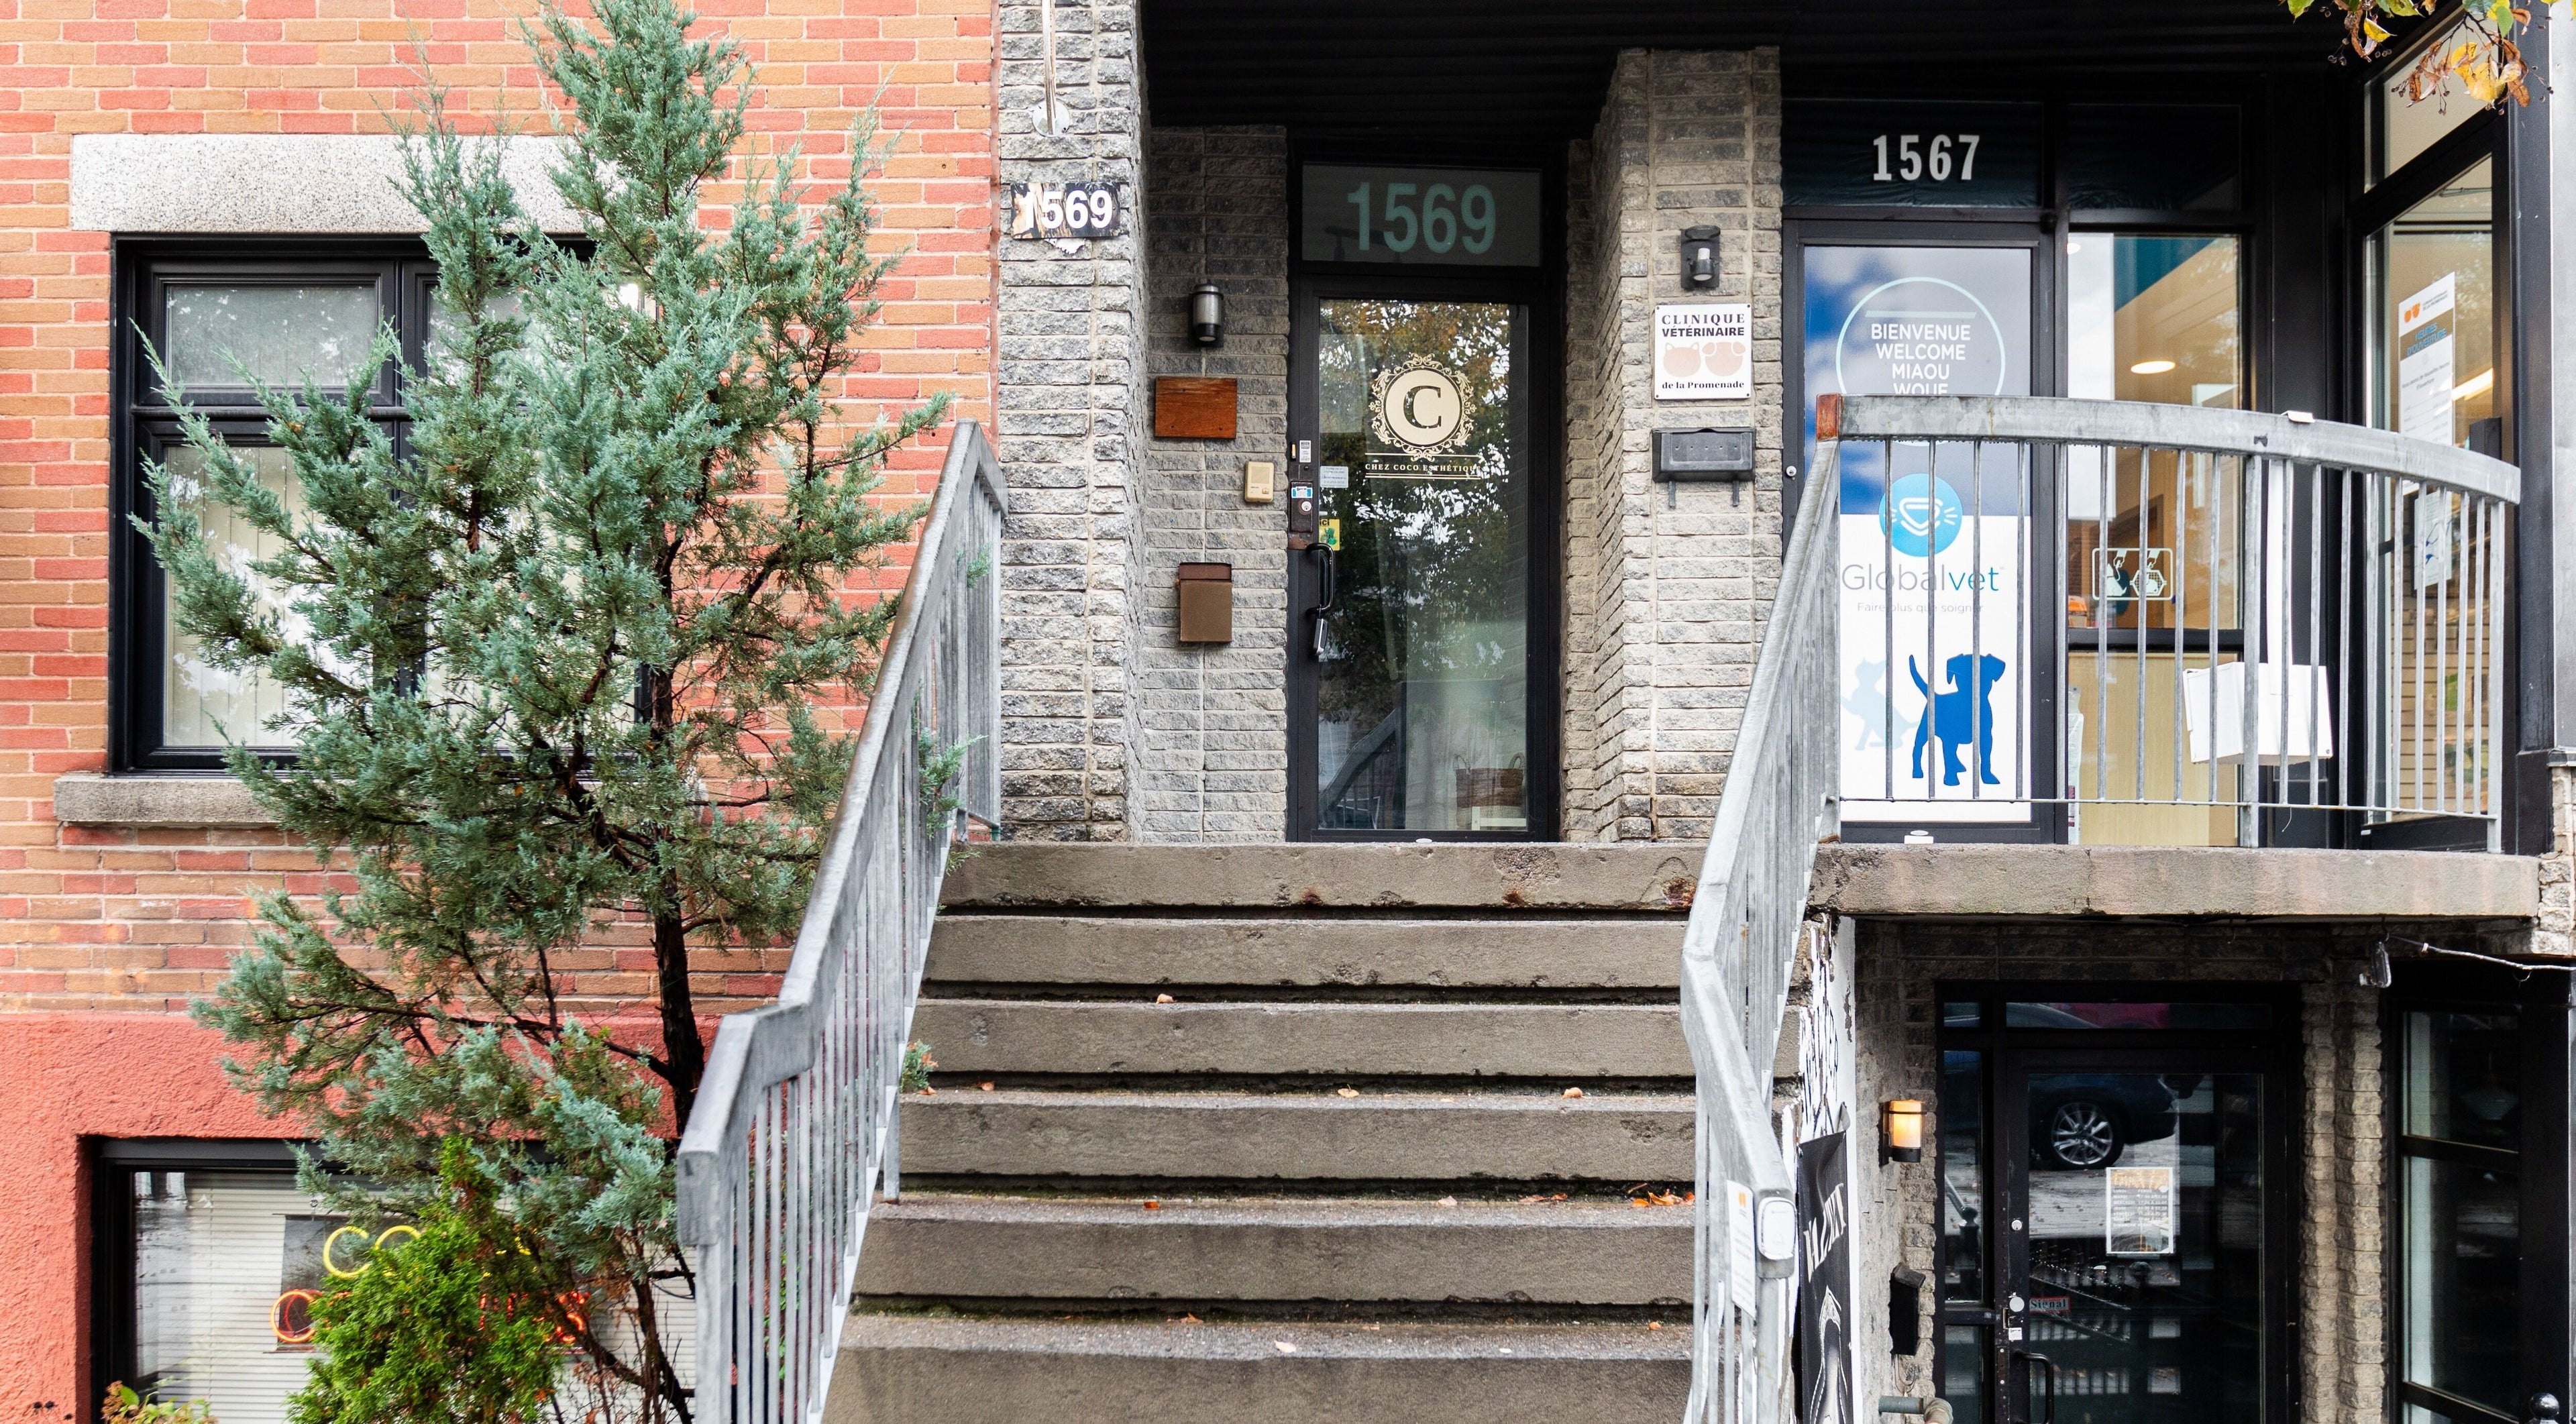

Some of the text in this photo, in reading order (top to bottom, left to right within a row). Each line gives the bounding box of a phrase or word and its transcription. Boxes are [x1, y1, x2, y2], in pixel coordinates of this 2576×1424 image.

[1873, 134, 1980, 180] 1567
[1018, 189, 1113, 229] 1569
[1347, 182, 1497, 254] 1569
[1662, 313, 1745, 325] CLINIQUE
[1662, 325, 1744, 337] VÉTÉRINAIRE
[1871, 323, 1971, 341] BIENVENUE
[1876, 343, 1966, 360] WELCOME
[1892, 363, 1949, 380] MIAOU
[1403, 385, 1442, 429] C
[1841, 563, 1999, 591] Globalvet
[1857, 602, 1885, 612] Faire
[1941, 603, 1984, 614] soignr
[2030, 1299, 2066, 1309] Signal
